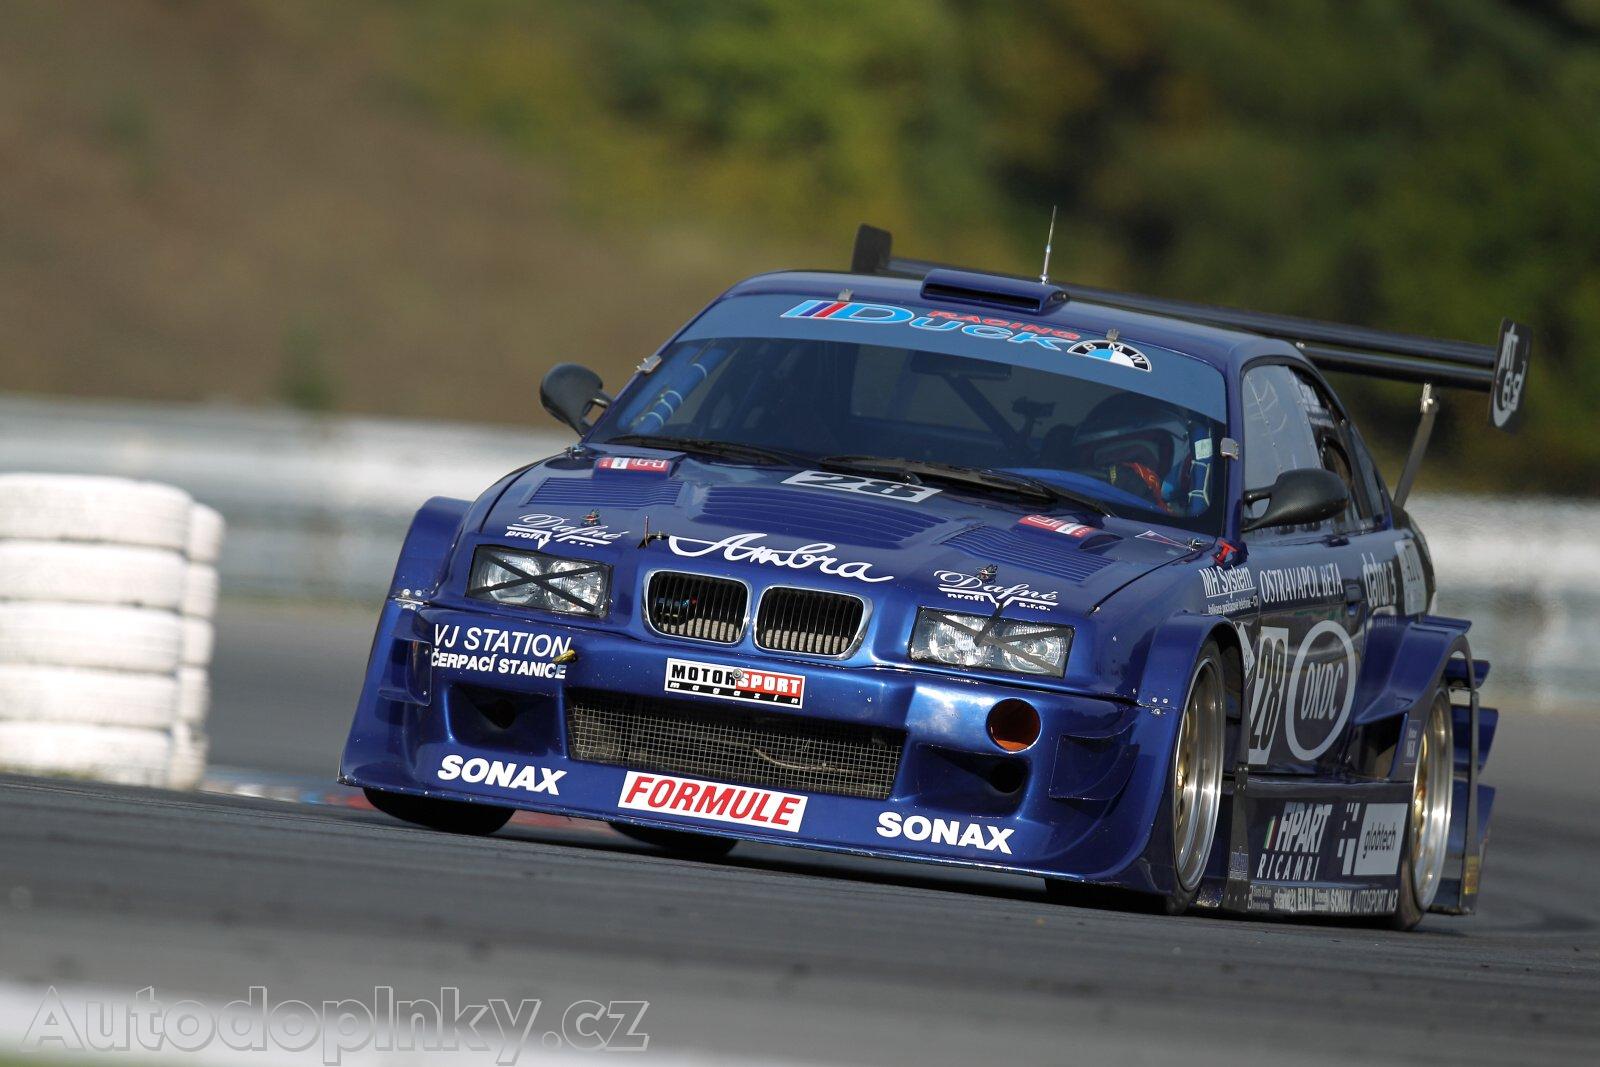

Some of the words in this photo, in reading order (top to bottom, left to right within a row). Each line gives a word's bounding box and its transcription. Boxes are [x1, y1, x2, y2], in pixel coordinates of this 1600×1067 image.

[927, 310, 1081, 341] RACING
[1082, 343, 1147, 365] BMW
[796, 473, 926, 498] 28
[668, 533, 894, 582] Ambra
[1199, 566, 1221, 597] MH
[1216, 564, 1253, 599] System
[1260, 565, 1321, 603] OSTRAVAPOL
[1319, 562, 1344, 597] BETA
[434, 624, 460, 648] VJ
[463, 627, 572, 658] STATION
[498, 660, 567, 680] STANICE
[671, 664, 801, 694] MOTORSPORT
[669, 682, 799, 704] magazin
[1248, 637, 1286, 751] 28
[437, 754, 567, 796] SONAX
[624, 776, 801, 826] FORMULE
[876, 811, 1015, 855] SONAX
[1256, 853, 1321, 881] RICAMBI
